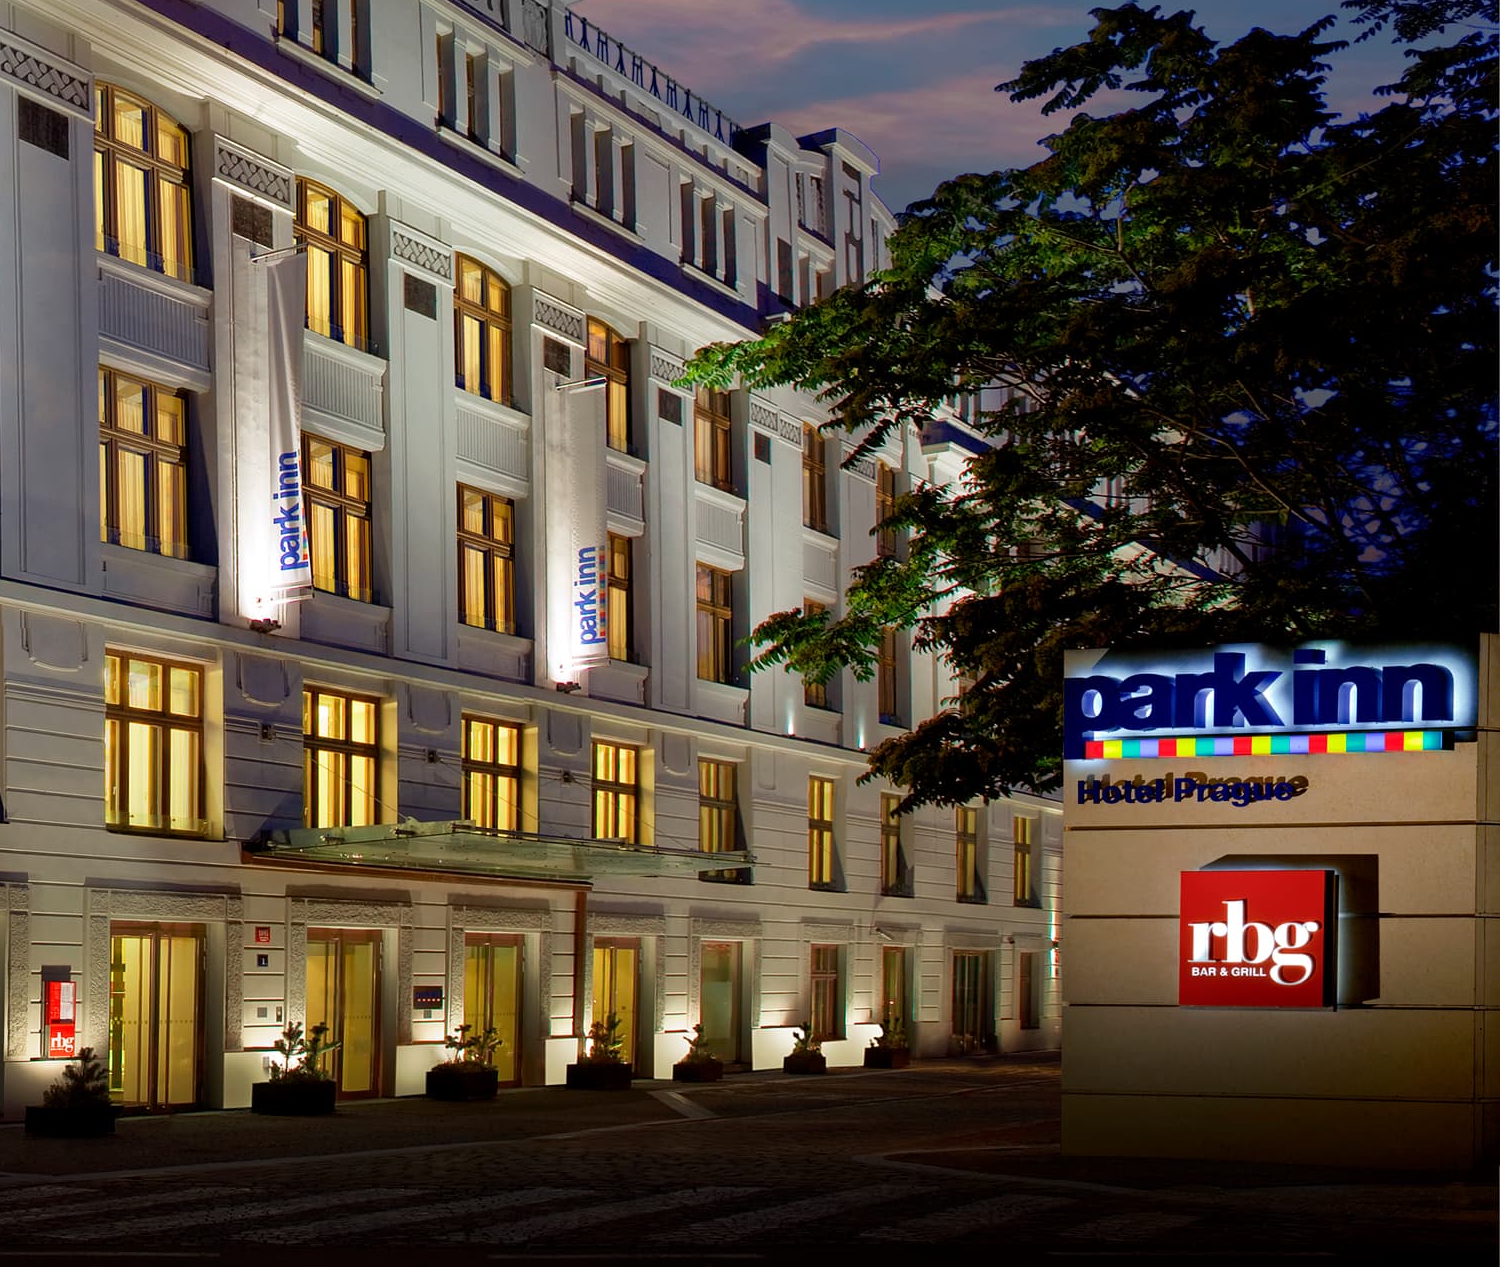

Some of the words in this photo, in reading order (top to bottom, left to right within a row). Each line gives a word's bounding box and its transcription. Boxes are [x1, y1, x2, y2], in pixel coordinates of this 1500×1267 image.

[273, 451, 299, 500] inn
[273, 503, 308, 570] park
[574, 547, 596, 586] inn
[574, 589, 606, 644] park
[1063, 652, 1285, 760] park
[1293, 648, 1454, 725] inn
[1077, 778, 1164, 805] Hotel
[1174, 778, 1295, 808] Prague
[1187, 899, 1319, 986] rbg
[1191, 967, 1217, 977] BAR
[1219, 967, 1229, 977] &
[1231, 967, 1267, 977] GRILL
[50, 1031, 75, 1053] rbg
